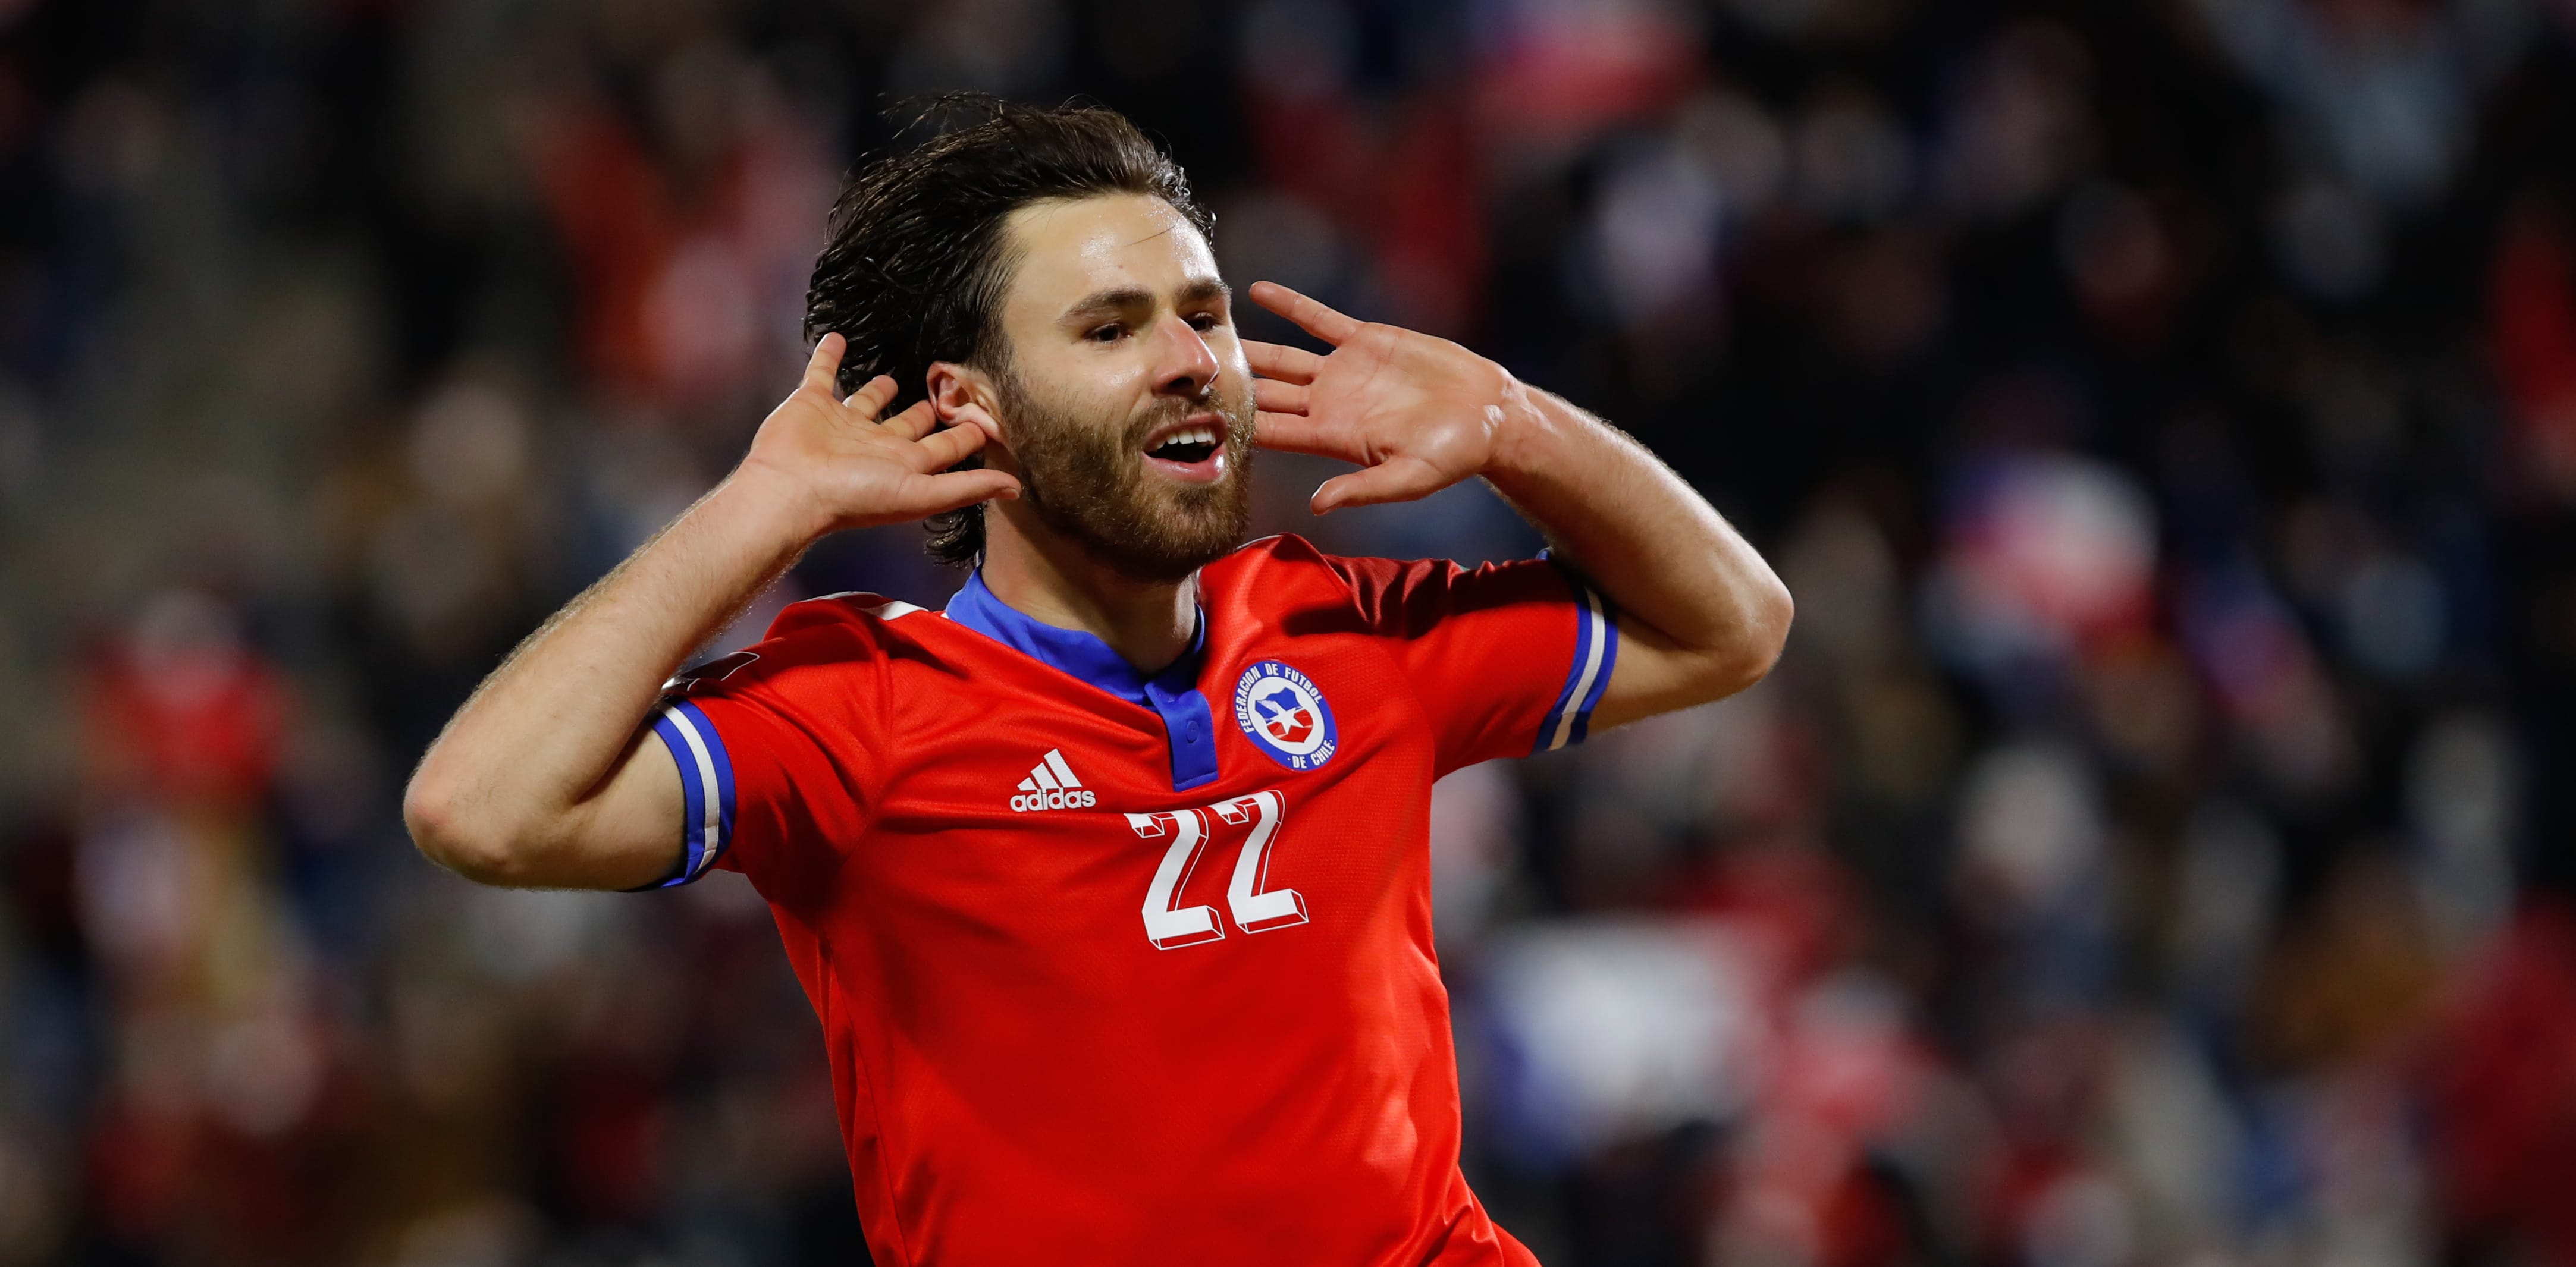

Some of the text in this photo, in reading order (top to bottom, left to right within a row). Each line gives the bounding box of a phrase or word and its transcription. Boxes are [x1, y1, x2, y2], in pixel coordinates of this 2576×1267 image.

[1236, 663, 1322, 733] FEDERACION DE FUTBOL
[1292, 741, 1335, 769] DE CHILE
[1011, 788, 1096, 812] adidas
[1124, 790, 1309, 950] 22
